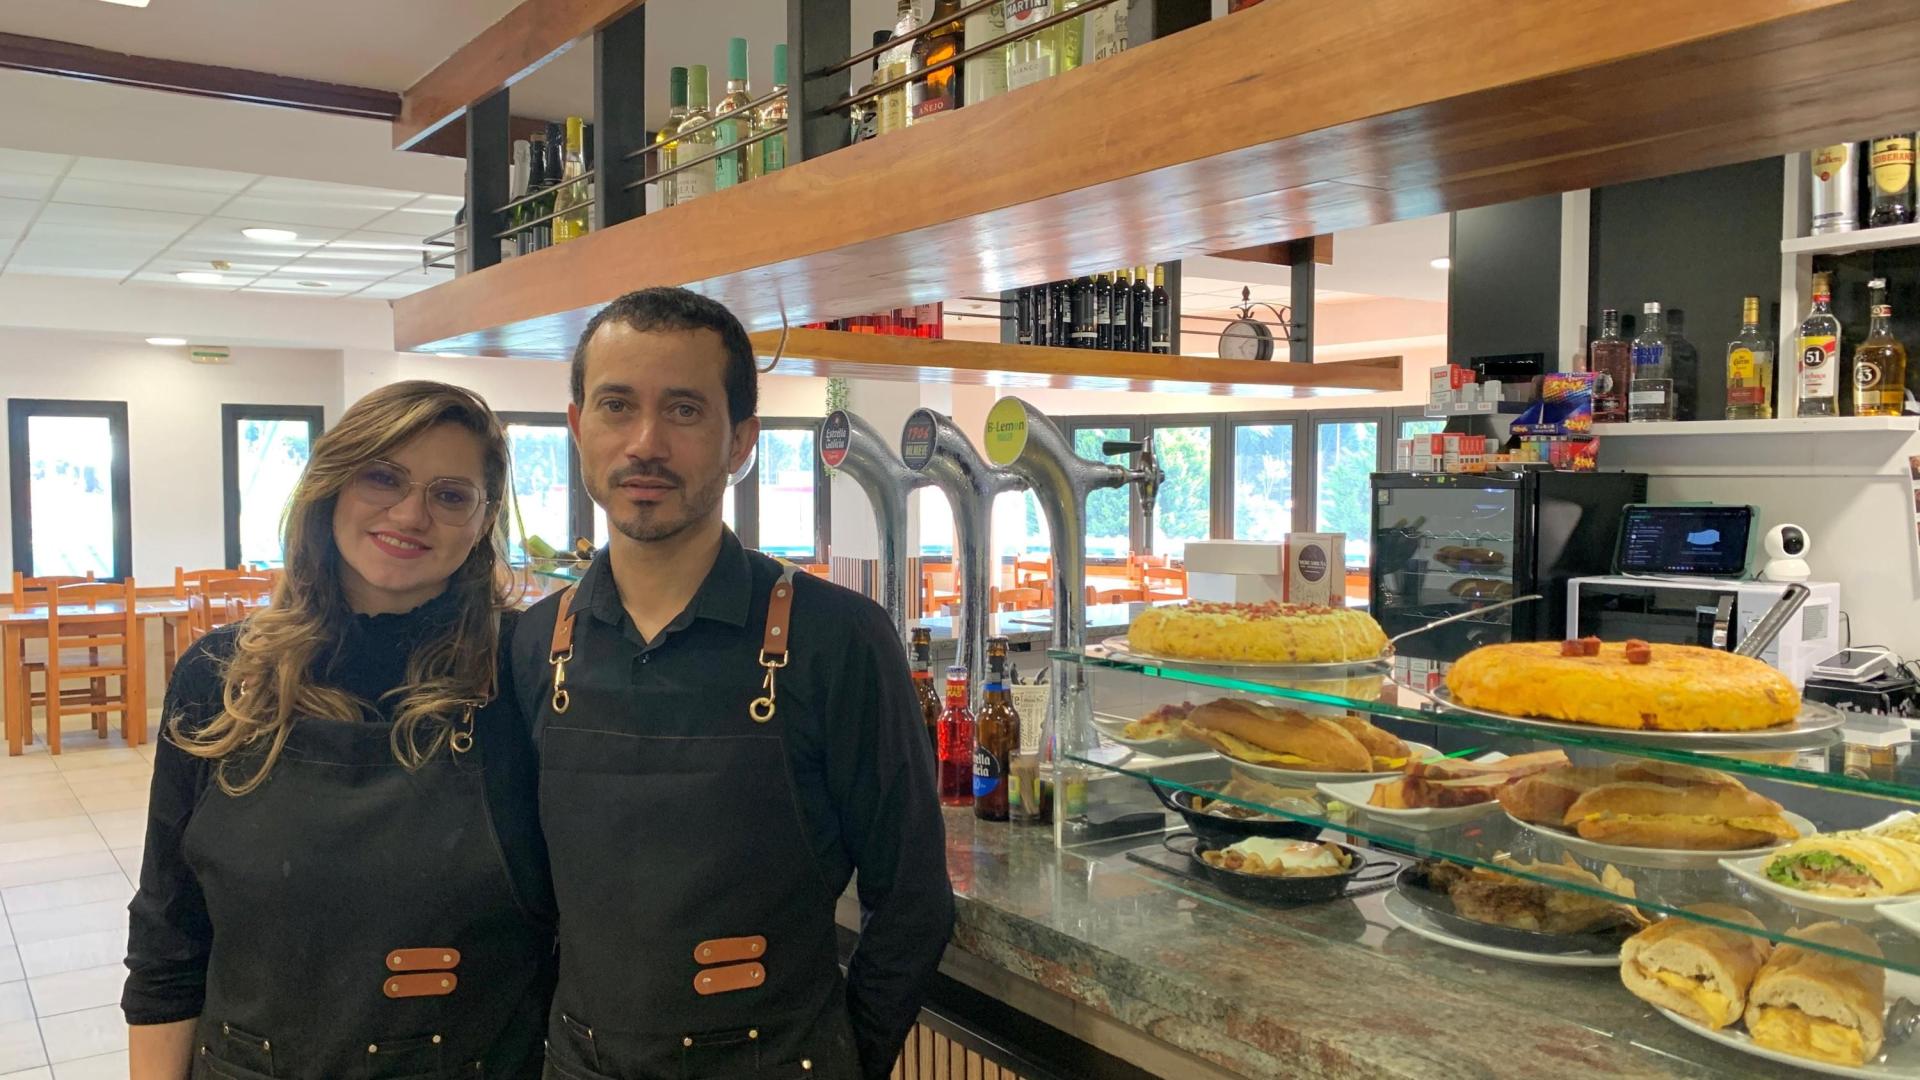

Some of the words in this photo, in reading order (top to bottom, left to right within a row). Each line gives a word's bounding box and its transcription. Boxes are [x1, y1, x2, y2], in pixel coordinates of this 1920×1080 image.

[919, 102, 944, 115] AÑEJO
[1806, 351, 1821, 363] 51
[1857, 368, 1873, 382] 43
